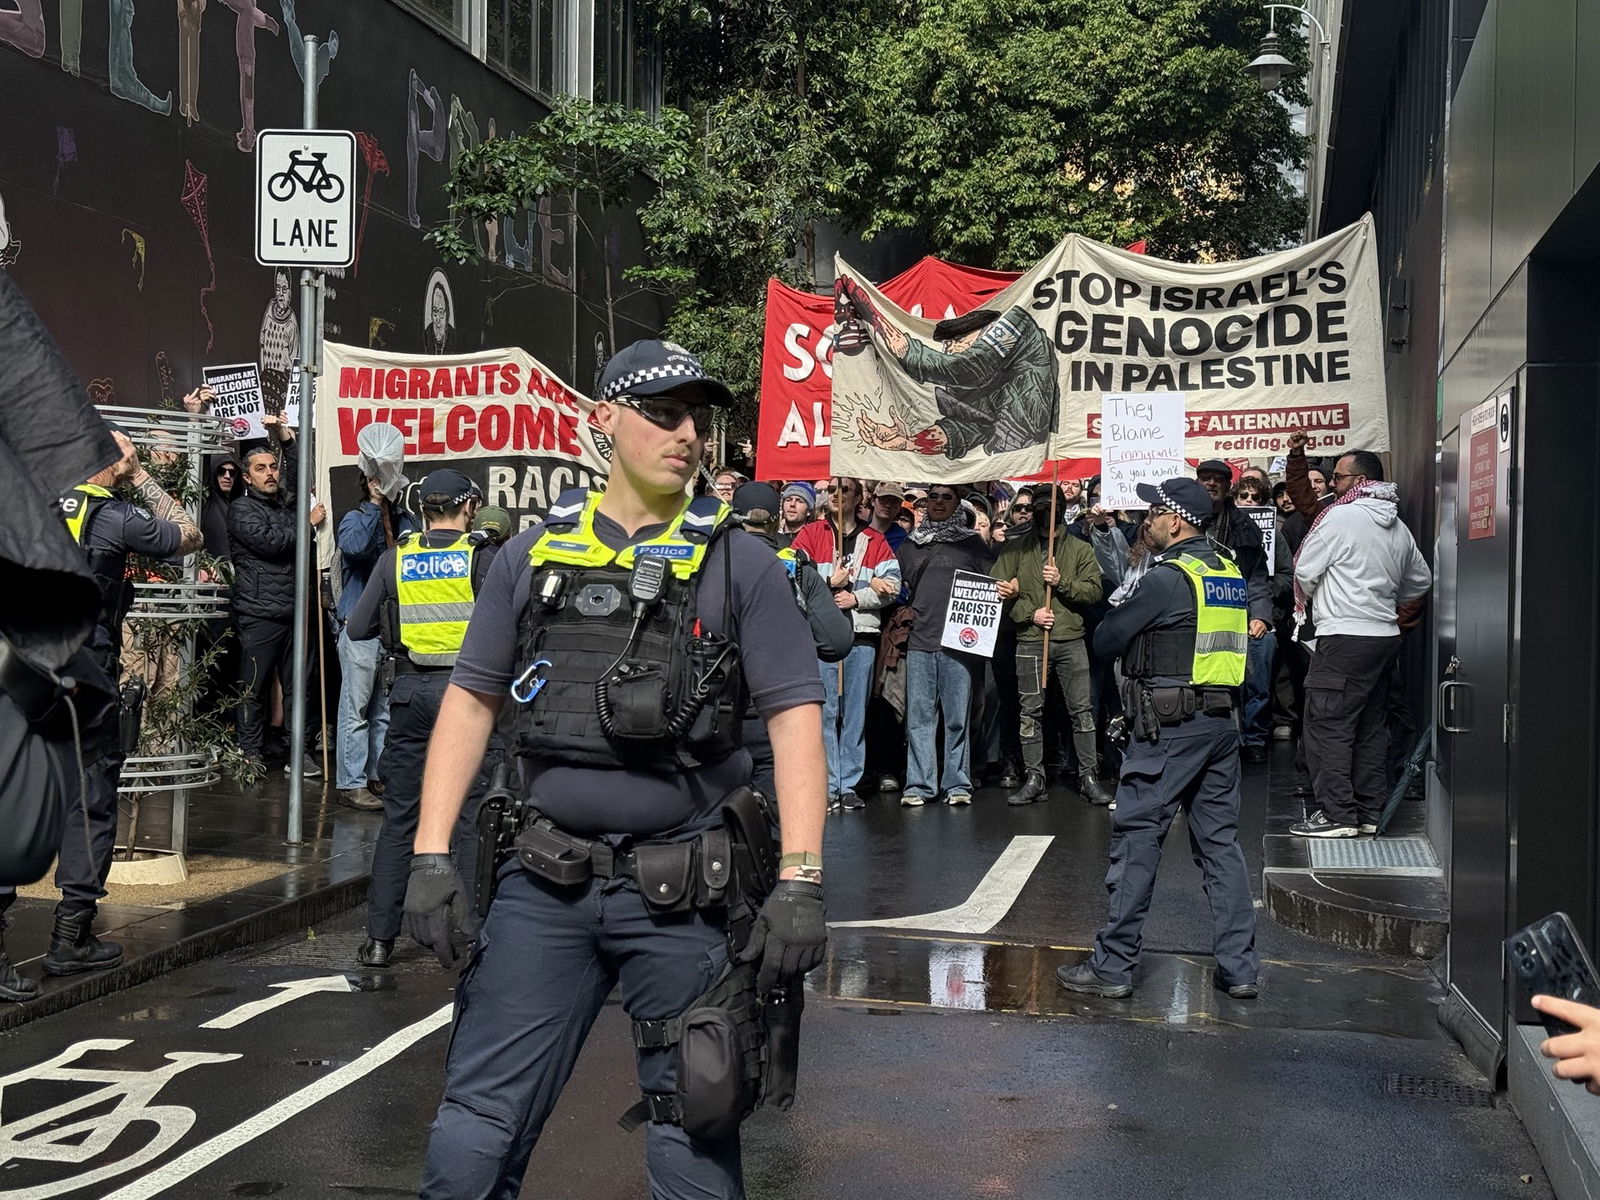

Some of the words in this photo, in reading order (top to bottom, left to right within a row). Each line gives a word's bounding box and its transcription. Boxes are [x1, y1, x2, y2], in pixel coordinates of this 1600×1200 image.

[273, 218, 338, 247] LANE
[1032, 270, 1142, 310] STOP
[1150, 261, 1347, 312] ISRAEL'S
[1055, 301, 1348, 357] GENOCIDE
[207, 371, 242, 385] MIGRANTS
[242, 369, 256, 379] ARE
[1071, 360, 1113, 391] IN
[1122, 350, 1351, 392] PALESTINE
[211, 378, 258, 394] WELCOME
[339, 363, 521, 400] MIGRANTS
[527, 367, 580, 414] ARE
[212, 390, 259, 408] RACISTS
[214, 405, 236, 418] ARE
[238, 401, 260, 416] NOT
[1108, 397, 1153, 422] They
[1206, 409, 1344, 431] ALTERNATIVE
[337, 404, 582, 456] WELCOME
[1110, 423, 1165, 441] Blame
[1214, 434, 1346, 451] redflag.g.au
[1110, 467, 1123, 480] So
[1130, 470, 1146, 482] you
[639, 545, 688, 556] Police
[402, 555, 467, 576] Police
[955, 579, 989, 590] MIGRANTS
[1205, 581, 1246, 601] Police
[954, 587, 1000, 602] WELCOME
[951, 600, 998, 616] RACISTS
[949, 612, 971, 625] ARE
[972, 615, 996, 628] NOT
